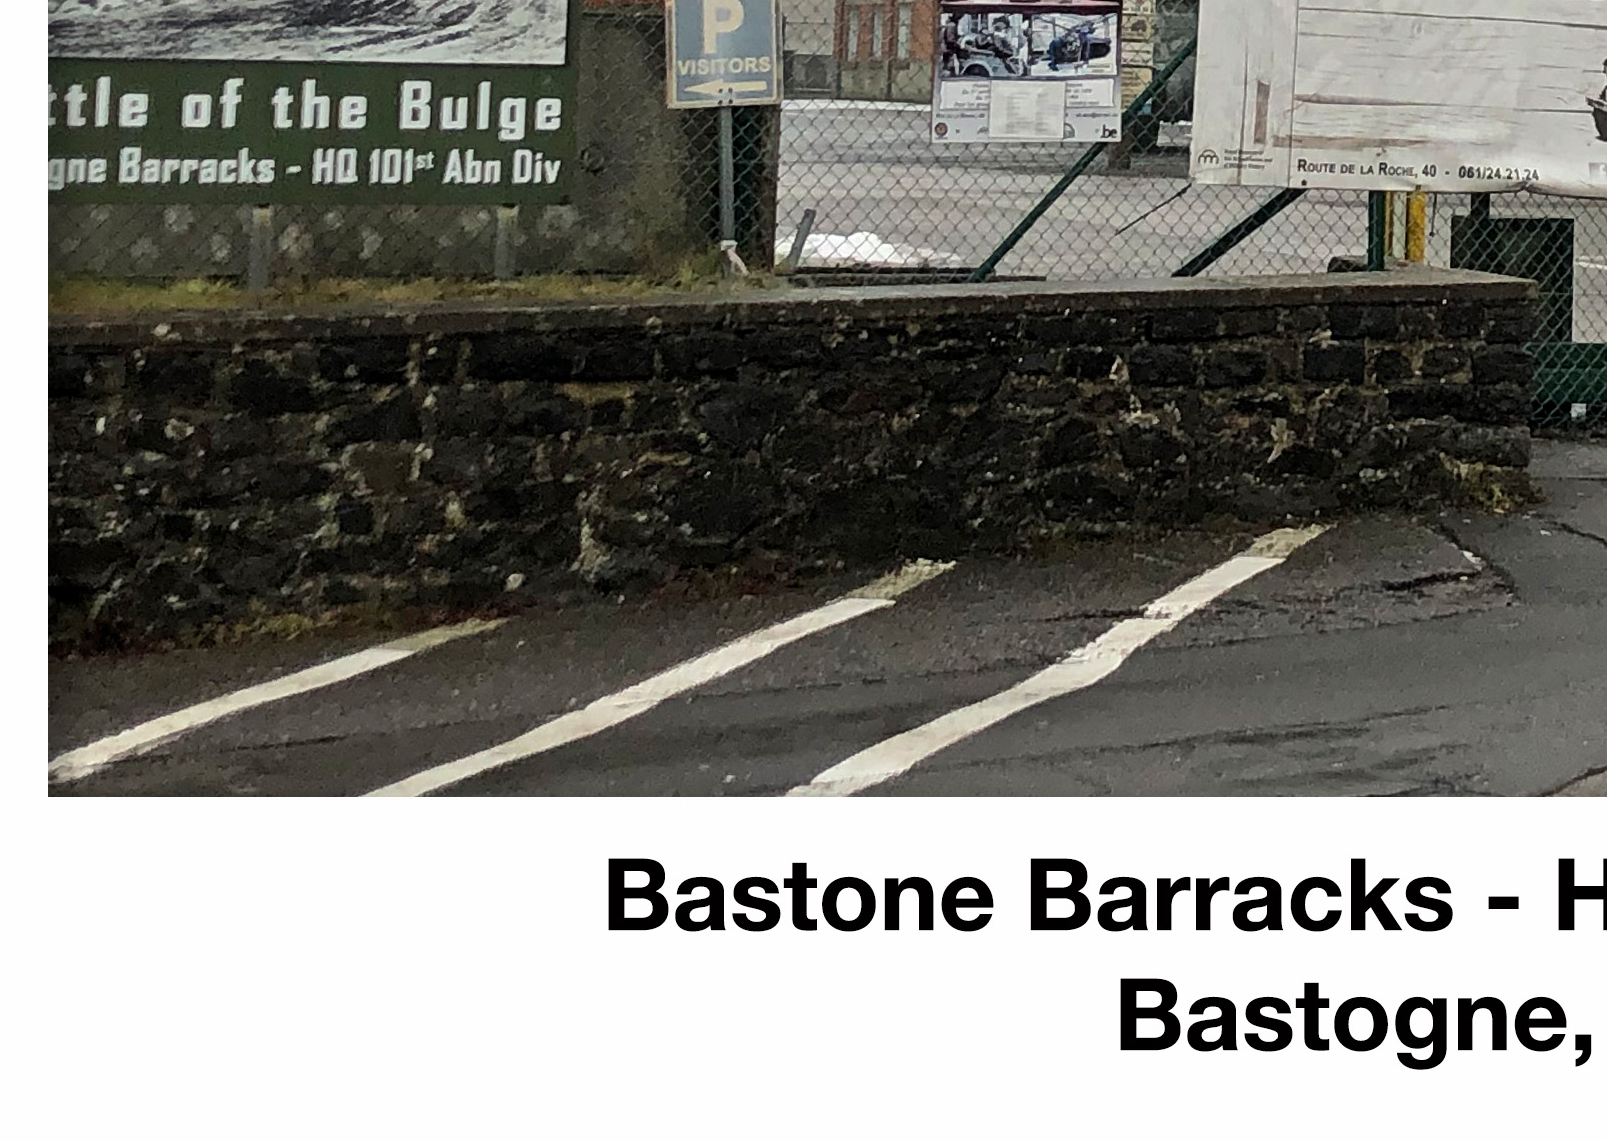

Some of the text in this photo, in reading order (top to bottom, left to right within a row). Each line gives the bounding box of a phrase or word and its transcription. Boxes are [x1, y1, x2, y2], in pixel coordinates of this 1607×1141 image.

[678, 57, 772, 76] VISITORS
[182, 77, 244, 128] of
[272, 78, 368, 129] the
[398, 79, 563, 141] Bulge
[118, 146, 275, 184] Barracks
[311, 147, 358, 185] HQ
[368, 148, 435, 185] 101st
[442, 148, 501, 184] Abn
[511, 148, 561, 184] Div
[1297, 158, 1336, 174] ROUTE
[1340, 164, 1356, 175] DE
[1360, 165, 1374, 175] LA
[1421, 164, 1437, 178] 40
[1458, 165, 1539, 181] 061/24.21.24
